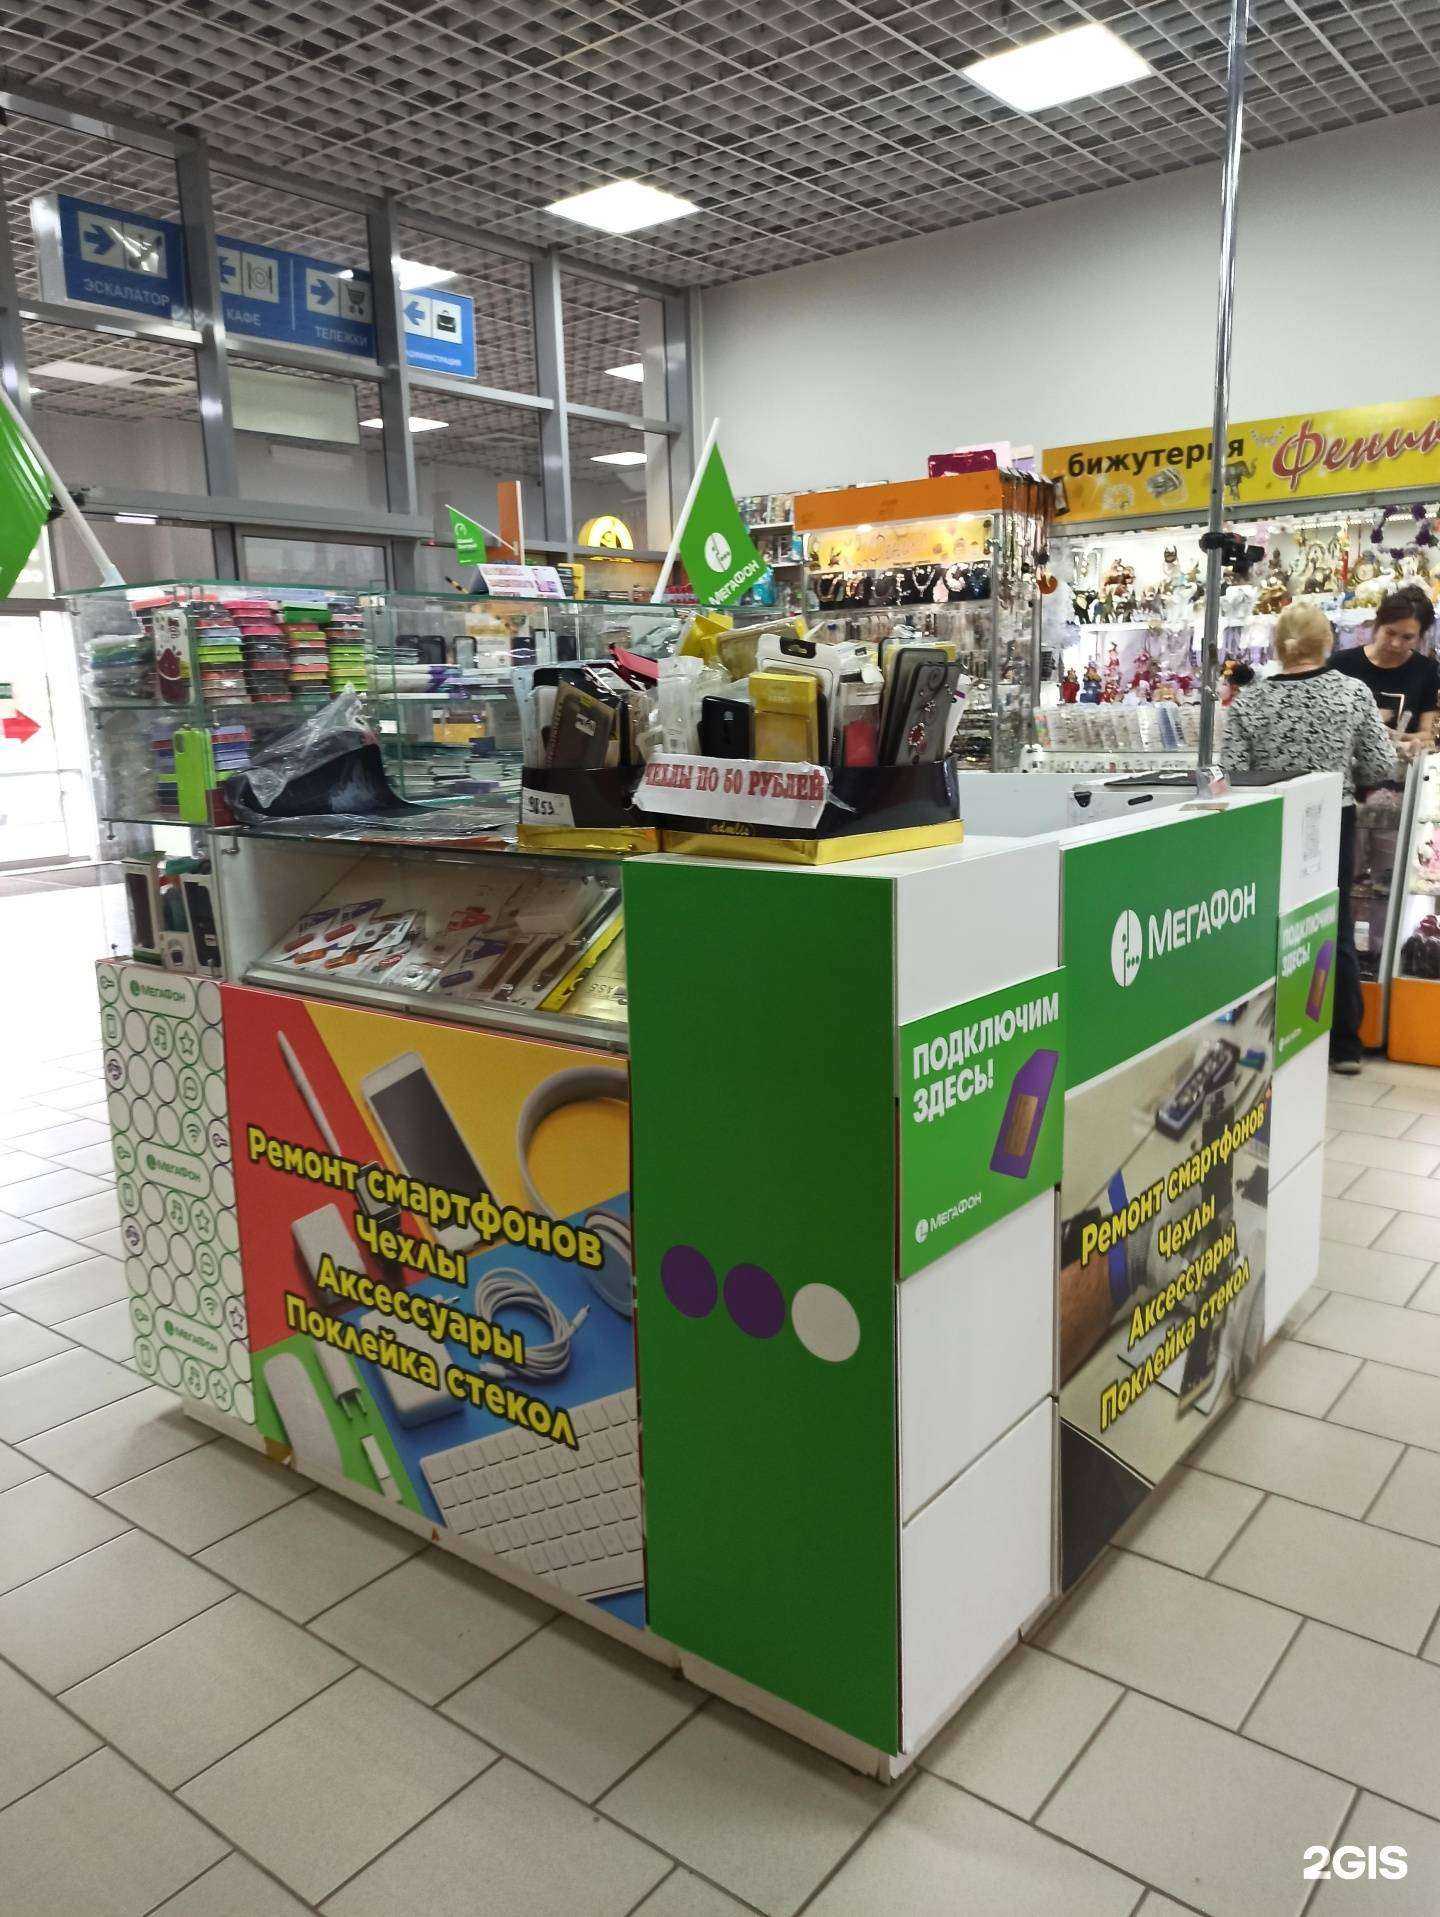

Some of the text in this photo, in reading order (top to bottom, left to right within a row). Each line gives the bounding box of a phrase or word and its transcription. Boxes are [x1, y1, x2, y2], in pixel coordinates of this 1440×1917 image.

[84, 279, 170, 306] ЭСКАЛАТОР
[226, 307, 261, 326] КАФЕ
[315, 326, 368, 346] ТЕЛЕЖКИ
[708, 560, 760, 605] МЕГАФОН
[696, 766, 718, 792] ПО
[723, 768, 743, 795] 50
[748, 769, 825, 801] РУБЛЕЙ
[1148, 882, 1256, 960] МЕГАФОН
[913, 992, 1059, 1080] ПОДКЛЮЧИМ
[913, 1058, 994, 1123] ЗДЕСЬ!
[247, 1124, 605, 1270] Ремонт смартфонов
[930, 1192, 982, 1232] МЕГАФОН
[1080, 1101, 1266, 1268] Ремонт смартфонов
[354, 1211, 468, 1286] Чехлы
[1157, 1193, 1216, 1260] Чехлы
[316, 1253, 526, 1366] Аксессуары
[1127, 1225, 1237, 1352] Аксессуары
[284, 1291, 579, 1450] Поклейка стекол
[1099, 1255, 1251, 1433] Поклейка стекол
